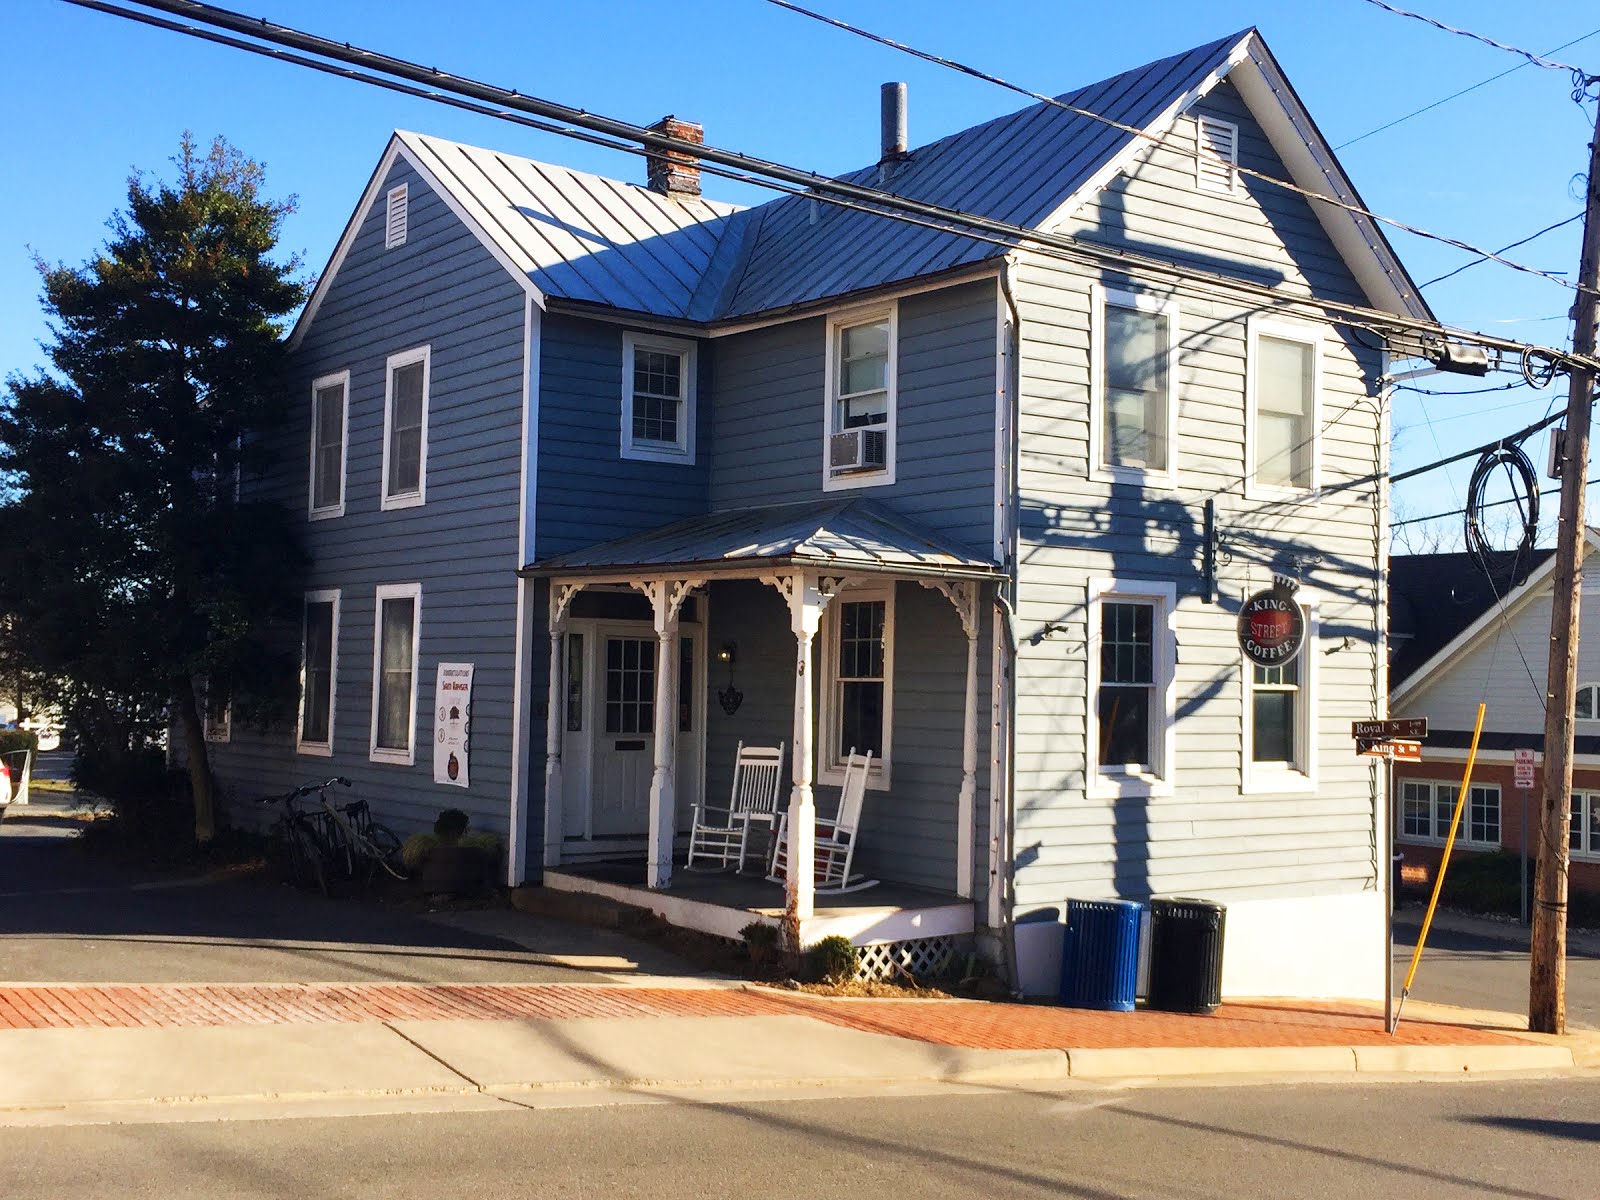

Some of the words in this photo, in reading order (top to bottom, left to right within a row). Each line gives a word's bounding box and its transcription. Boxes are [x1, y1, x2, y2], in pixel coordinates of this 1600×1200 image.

[1253, 599, 1287, 611] KING
[1250, 622, 1288, 638] STREET
[1246, 640, 1293, 658] COFFEE
[1356, 722, 1385, 737] Royal
[1392, 723, 1400, 731] St
[1371, 740, 1395, 757] King
[1398, 744, 1406, 753] St
